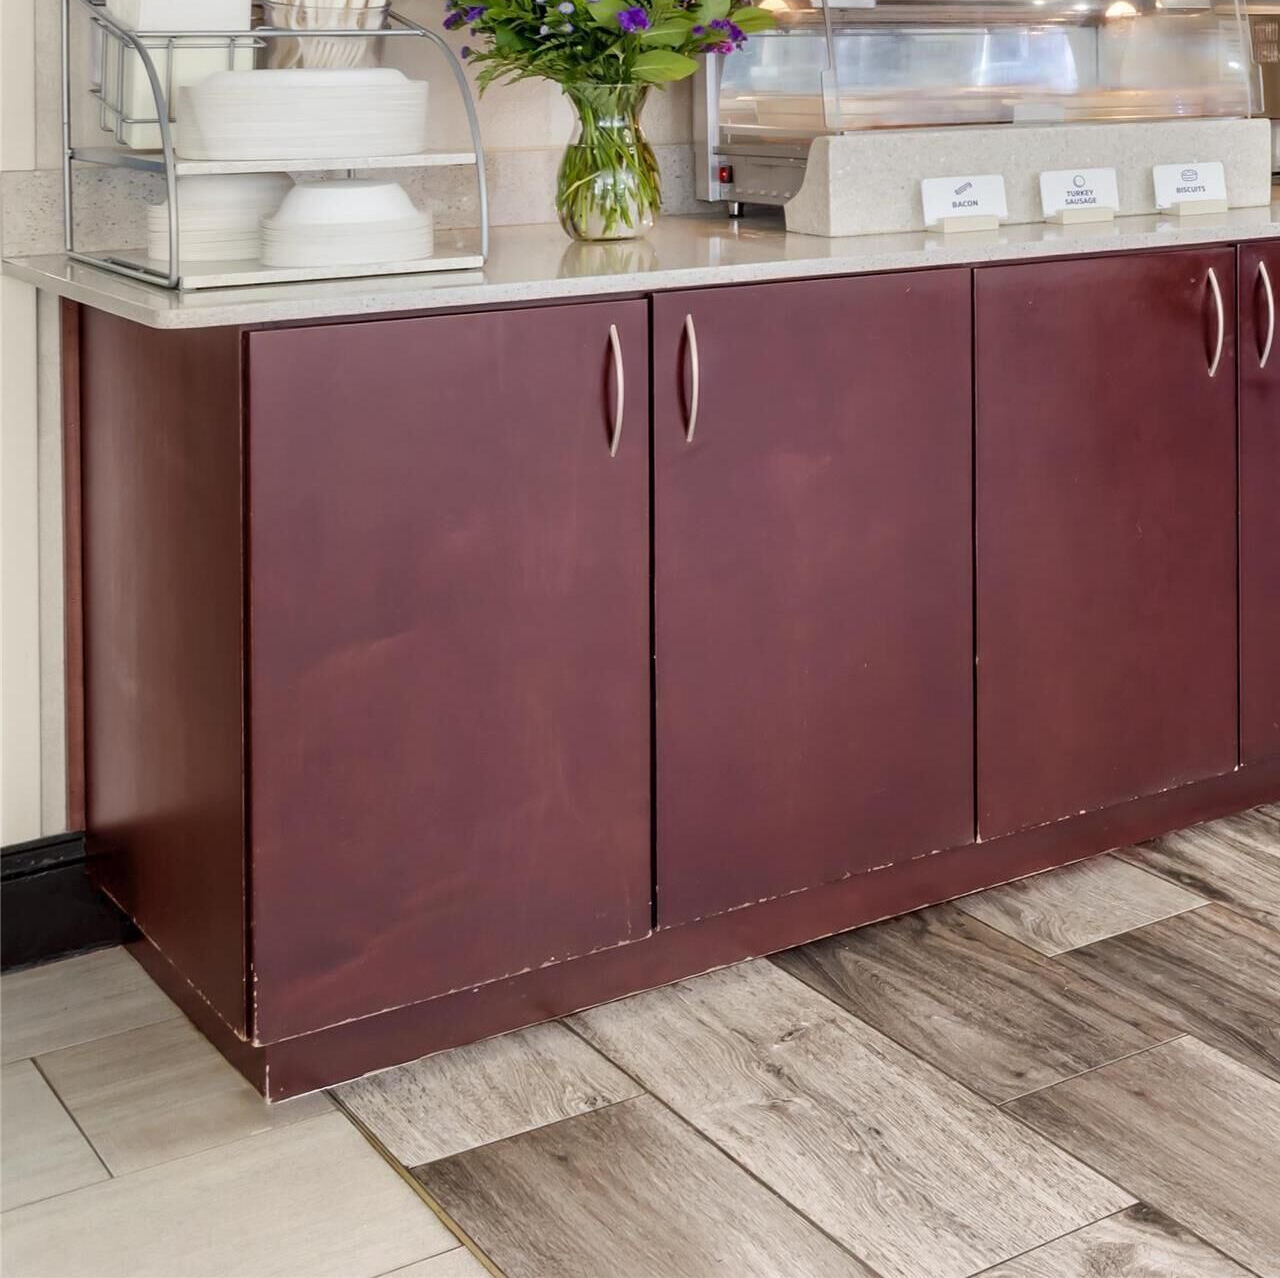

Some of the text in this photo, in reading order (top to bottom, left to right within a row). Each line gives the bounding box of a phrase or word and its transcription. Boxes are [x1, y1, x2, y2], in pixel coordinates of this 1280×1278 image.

[1066, 189, 1095, 197] TURKEY
[952, 200, 979, 208] BACON
[1065, 197, 1096, 205] SAUSAGE
